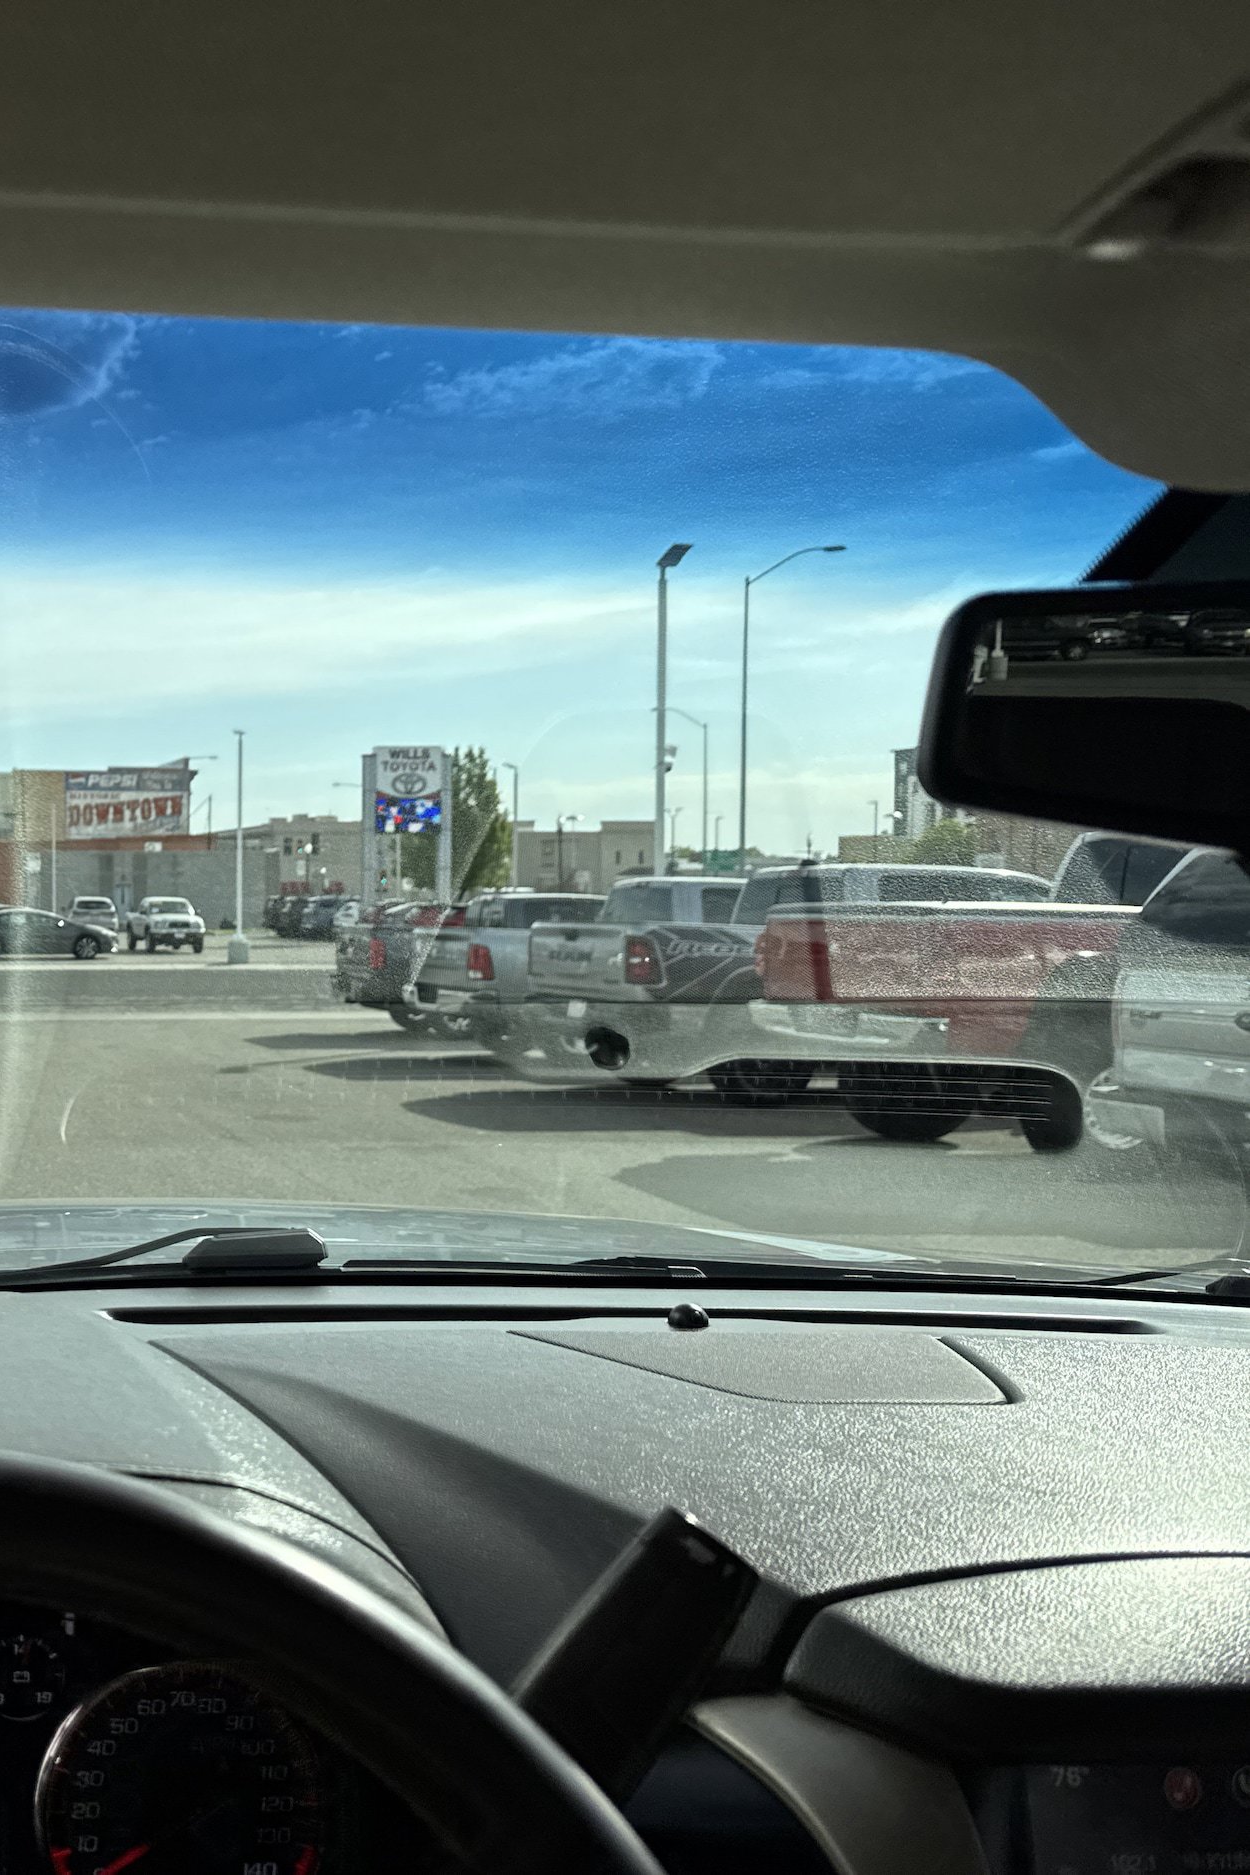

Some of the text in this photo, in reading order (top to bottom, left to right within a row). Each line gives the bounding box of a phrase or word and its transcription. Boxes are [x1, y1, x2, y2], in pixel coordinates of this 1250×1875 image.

[389, 748, 430, 759] WILLS
[381, 761, 437, 772] TOYOTA
[87, 774, 138, 788] PEPSI
[68, 795, 184, 828] DOWNTOWN
[170, 1690, 196, 1706] 70
[137, 1699, 167, 1716] 60
[110, 1718, 139, 1735] 50
[86, 1739, 117, 1757] 40
[76, 1770, 105, 1788] 30
[71, 1801, 101, 1820] 20
[77, 1835, 98, 1853] 10
